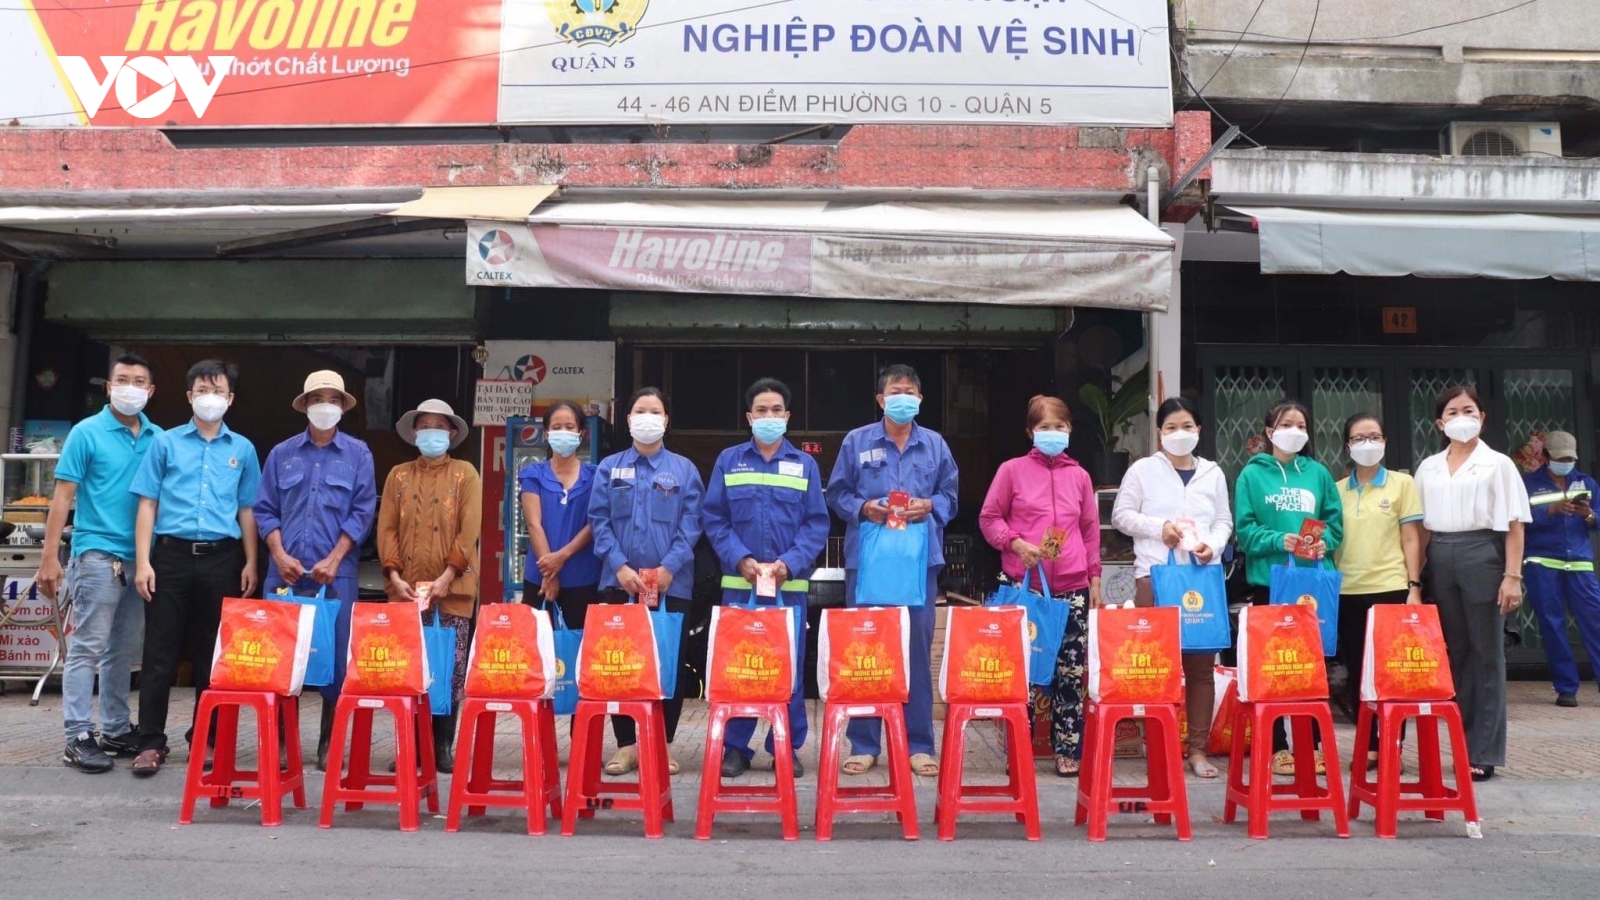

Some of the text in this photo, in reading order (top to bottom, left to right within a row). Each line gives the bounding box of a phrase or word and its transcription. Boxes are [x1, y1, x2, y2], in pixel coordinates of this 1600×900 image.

[124, 0, 417, 51] Havoline
[683, 16, 1136, 60] NGHIỆP ĐOÀN VỆ SINH
[274, 52, 326, 76] Chất
[332, 56, 410, 80] Lượng
[551, 54, 636, 72] QUẬN 5
[617, 95, 642, 112] 44
[664, 95, 691, 112] 46
[698, 95, 730, 112] AN
[805, 91, 908, 113] PHƯỜNG
[917, 96, 942, 113] 10
[964, 93, 1033, 117] QUẬN
[1040, 97, 1052, 115] 5
[608, 228, 786, 273] Havoline
[476, 270, 513, 281] CALTEX
[636, 270, 664, 285] Dầu
[552, 366, 585, 375] CALTEX
[1264, 494, 1301, 504] NORTH
[1280, 487, 1300, 496] THE
[1276, 503, 1301, 511] FACE
[3, 581, 39, 600] 44
[17, 635, 40, 645] xào
[370, 644, 390, 661] Tết
[492, 647, 511, 662] Tết
[605, 649, 625, 664] Tết
[1130, 652, 1152, 667] Tết
[1404, 646, 1426, 661] Tết
[744, 653, 764, 669] Tết
[855, 654, 877, 669] Tết
[979, 656, 1001, 671] Tết
